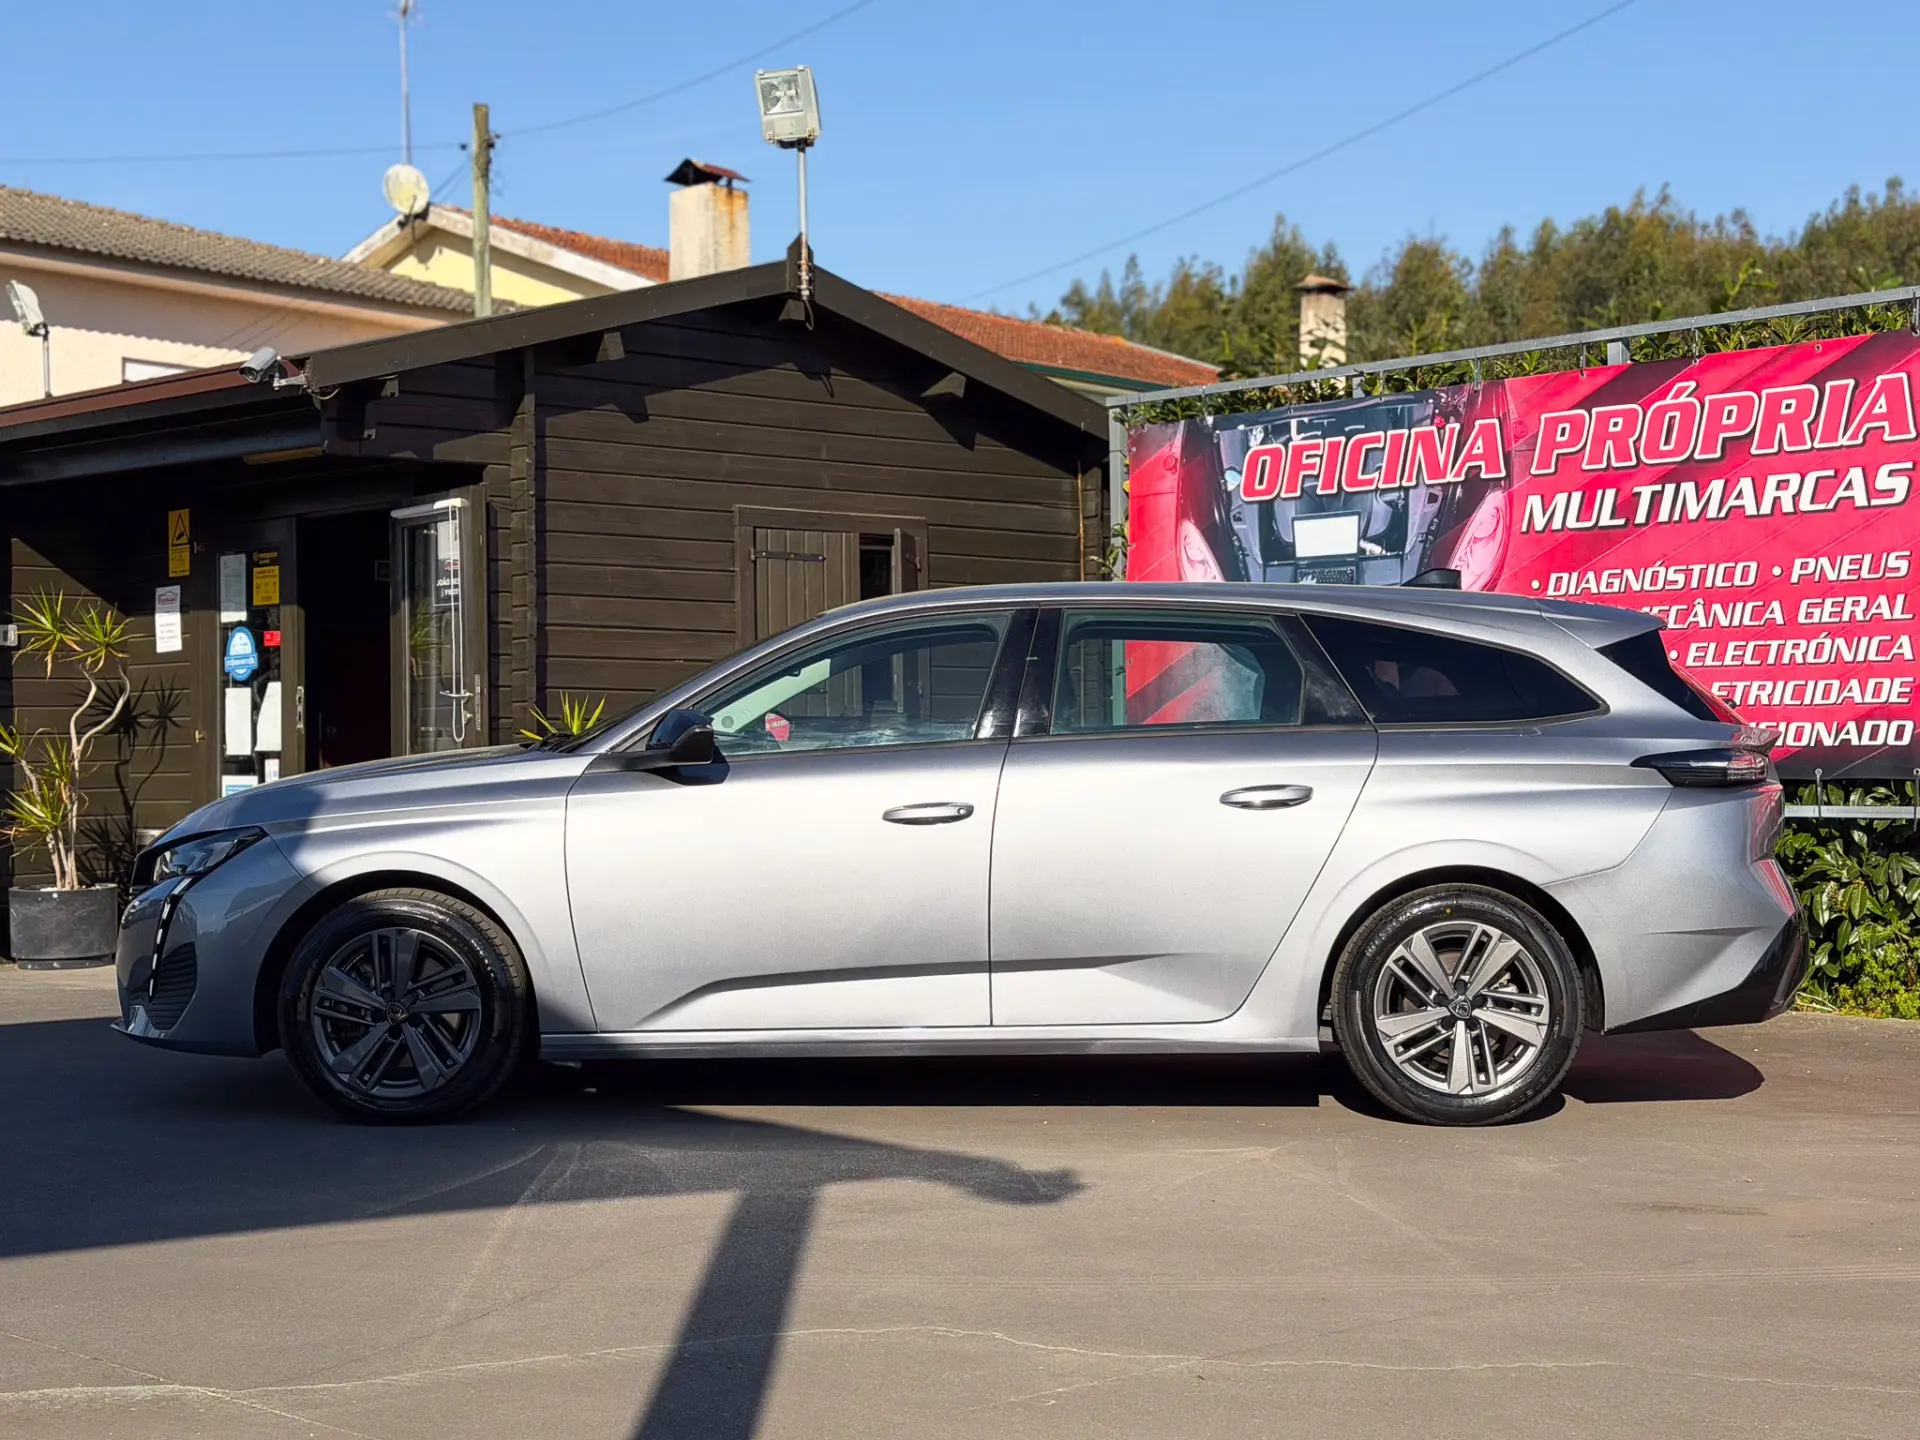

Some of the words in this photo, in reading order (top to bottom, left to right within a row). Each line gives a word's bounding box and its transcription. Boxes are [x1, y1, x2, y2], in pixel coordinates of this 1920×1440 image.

[1240, 417, 1506, 501] OFICINA
[1530, 372, 1917, 475] PRÓPRIA
[1520, 462, 1914, 532] MULTIMARCAS
[1548, 560, 1758, 597] DIAGNÓSTICO
[1789, 550, 1911, 584] PNEUS
[1797, 593, 1914, 624] GERAL
[1685, 631, 1915, 667] ELECTRÓNICA
[1710, 677, 1914, 706] ETRICIDADE
